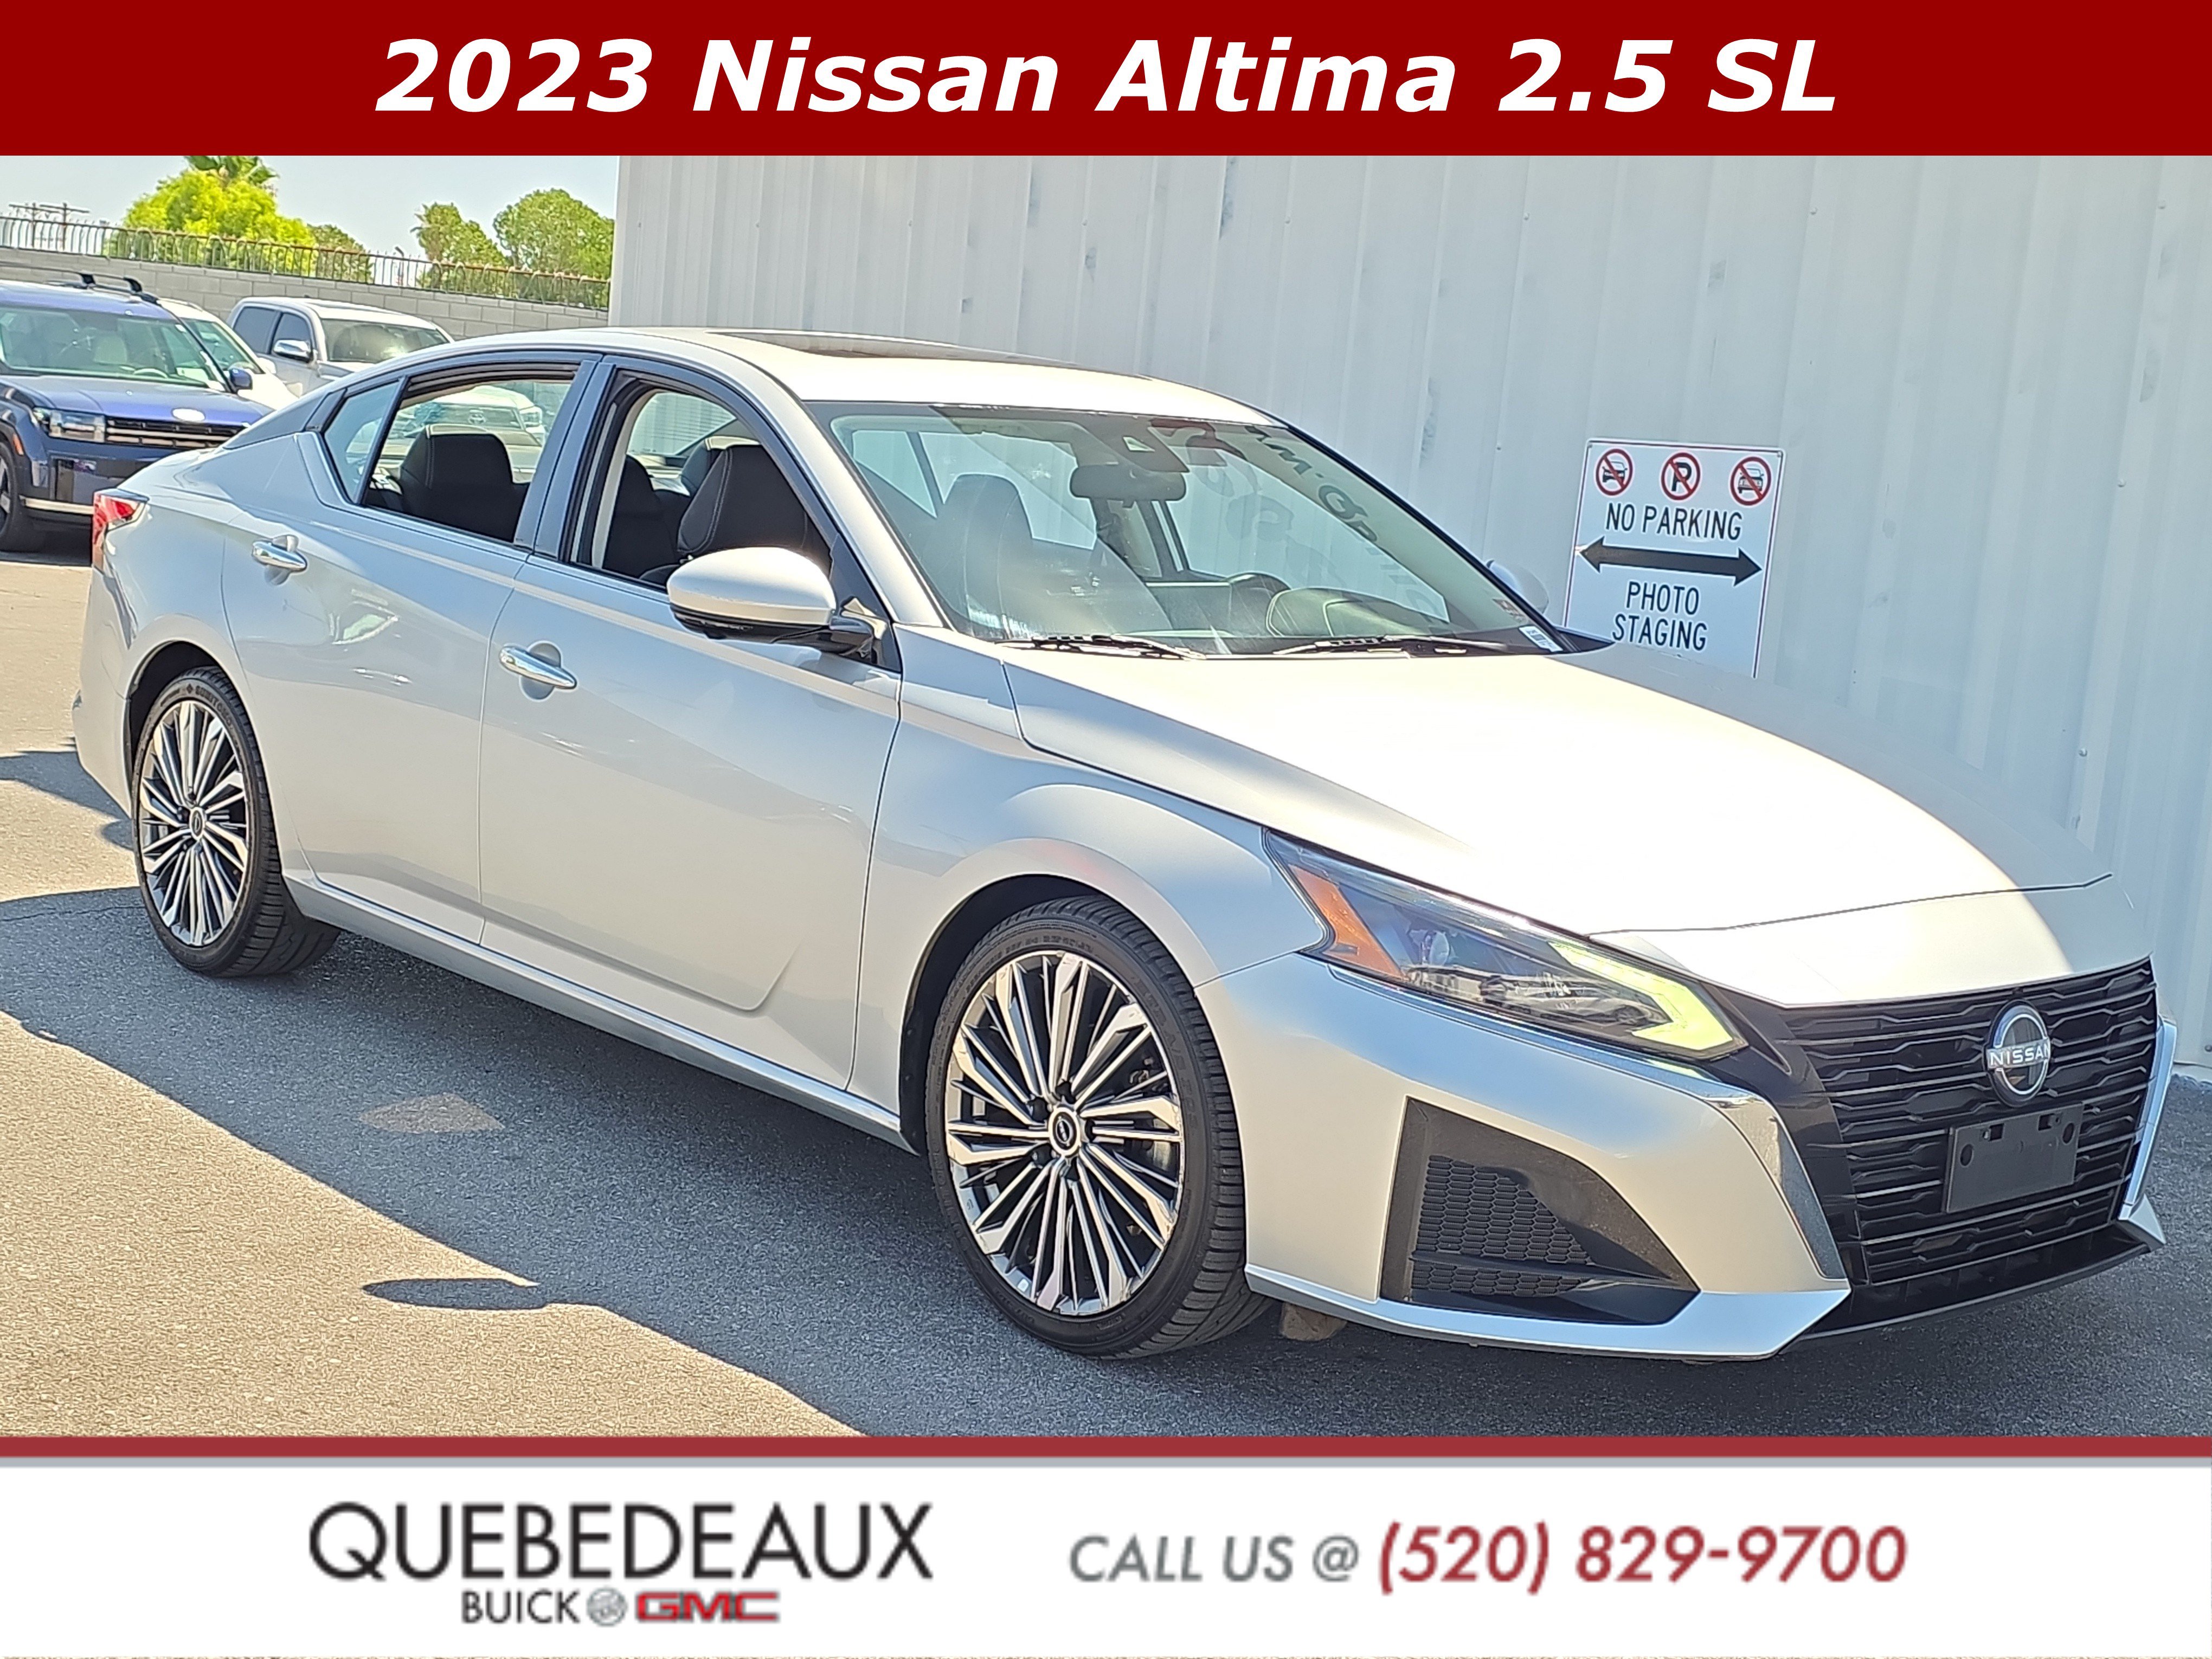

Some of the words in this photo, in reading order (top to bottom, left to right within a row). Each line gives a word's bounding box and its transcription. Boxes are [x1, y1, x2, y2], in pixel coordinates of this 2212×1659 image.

[1606, 503, 1635, 531] NO
[1643, 506, 1742, 540] PARKING
[1626, 581, 1699, 615] PHOTO
[1612, 614, 1707, 651] STAGING
[1989, 1040, 2050, 1068] NISSAN
